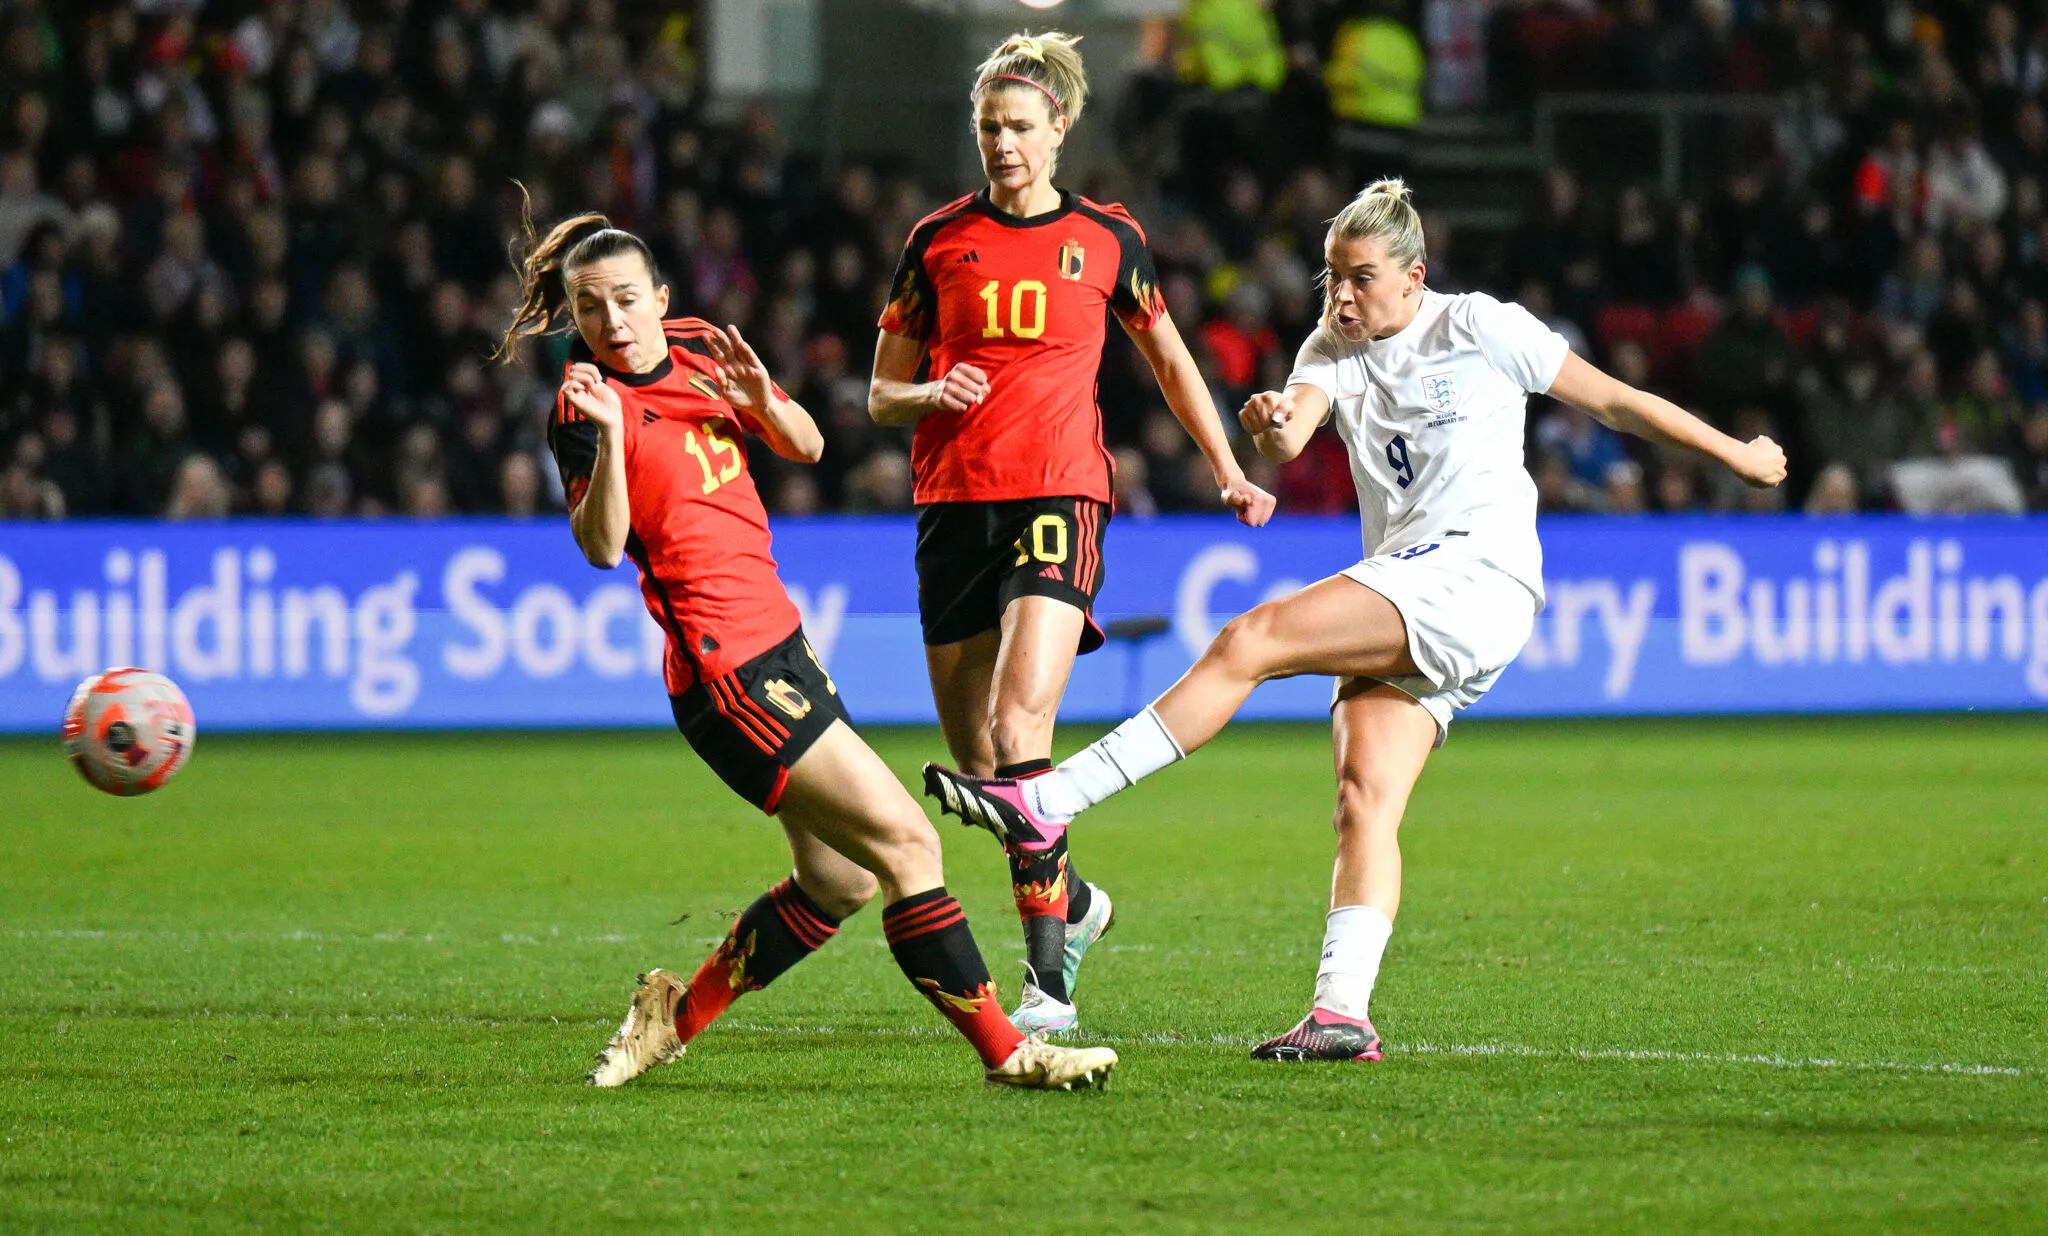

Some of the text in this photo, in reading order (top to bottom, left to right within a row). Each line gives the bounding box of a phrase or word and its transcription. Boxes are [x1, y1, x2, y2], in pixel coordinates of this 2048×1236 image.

[979, 280, 1047, 338] 10
[685, 413, 741, 495] 15
[1386, 434, 1414, 489] 9
